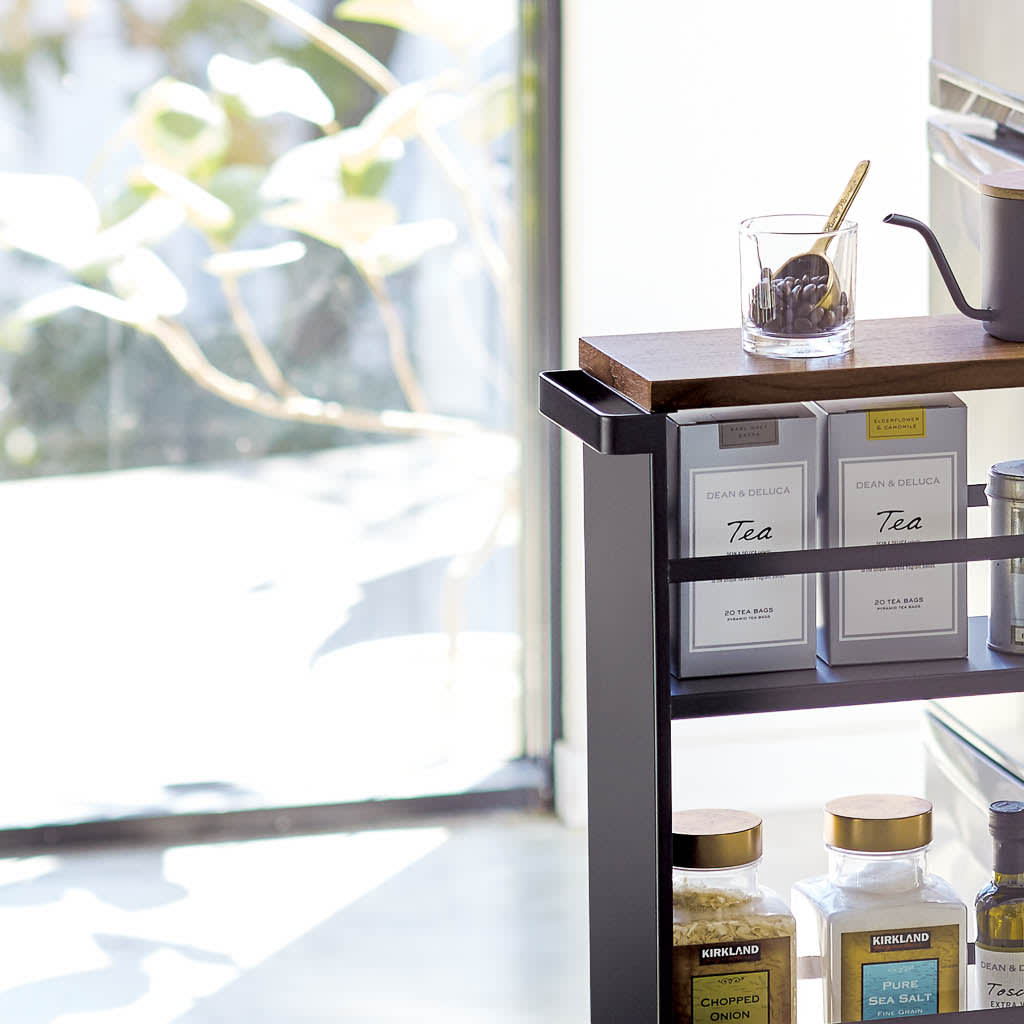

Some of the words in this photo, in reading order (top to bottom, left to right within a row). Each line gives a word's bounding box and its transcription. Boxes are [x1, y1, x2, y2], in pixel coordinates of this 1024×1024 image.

[856, 480, 885, 489] DEAN
[887, 479, 895, 488] &
[897, 476, 940, 487] DELUCA
[706, 490, 736, 500] DEAN
[738, 489, 745, 498] &
[748, 486, 791, 497] DELUCA
[877, 509, 923, 533] Tea
[727, 520, 773, 543] Tea
[903, 596, 924, 604] BAGS
[872, 932, 929, 946] KIRKLAND
[702, 945, 760, 959] KIRKLAND
[981, 961, 1006, 972] DEAN
[1008, 964, 1016, 972] &
[883, 980, 918, 990] PURE
[701, 995, 760, 1007] CHOPPED
[869, 996, 894, 1006] SEA
[900, 993, 932, 1003] SALT
[710, 1011, 750, 1022] ONION
